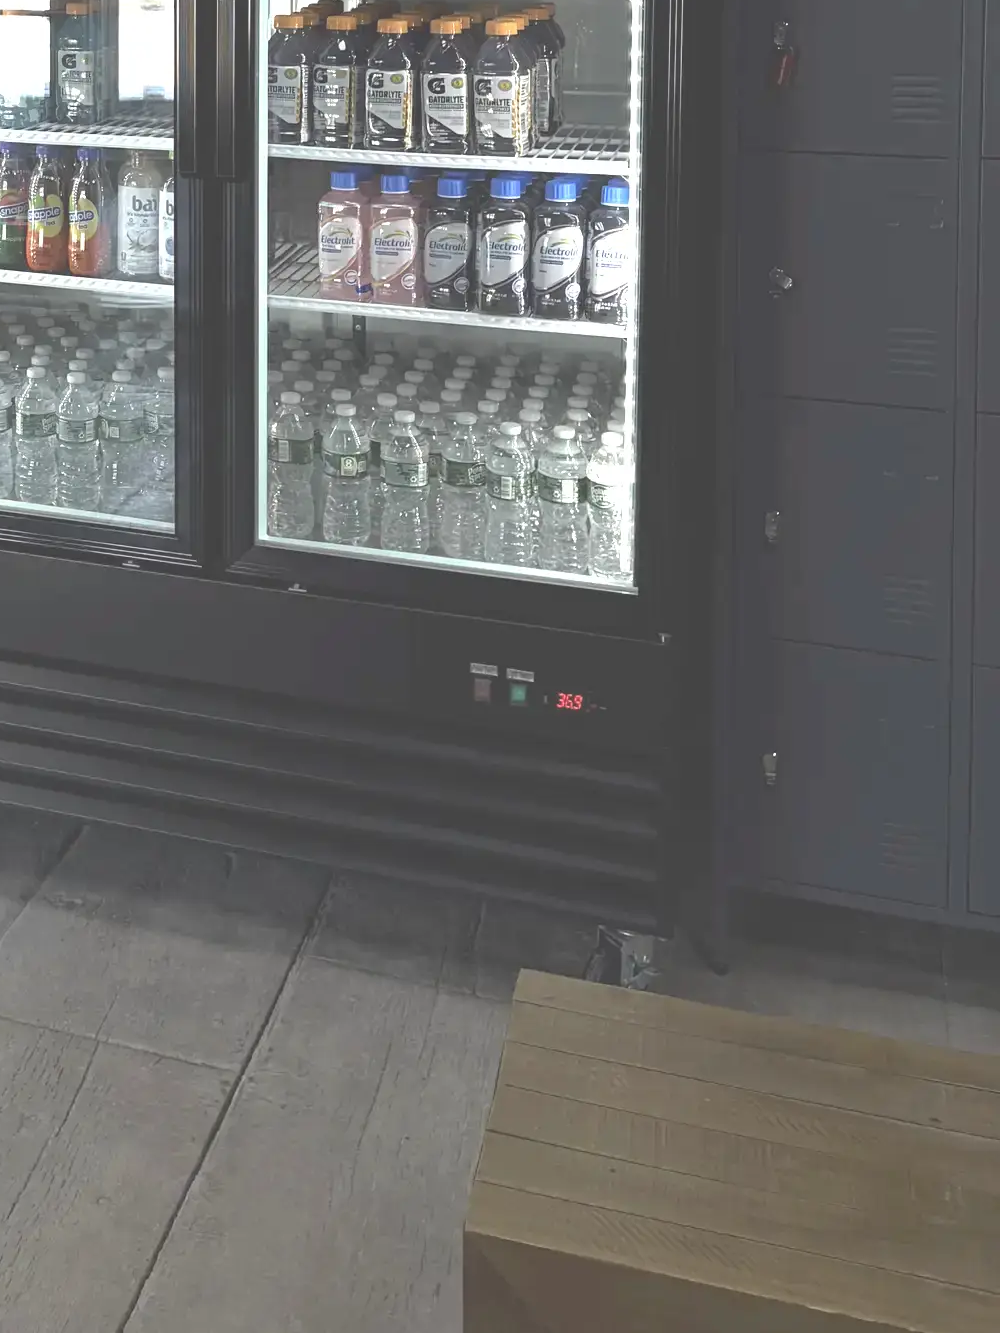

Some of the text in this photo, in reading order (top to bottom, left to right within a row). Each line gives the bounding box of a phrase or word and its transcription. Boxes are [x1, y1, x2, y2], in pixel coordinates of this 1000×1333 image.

[427, 77, 446, 94] G
[475, 78, 492, 96] G
[428, 95, 464, 104] GATORLYTE
[132, 194, 158, 212] bai
[321, 234, 356, 246] Electrolit
